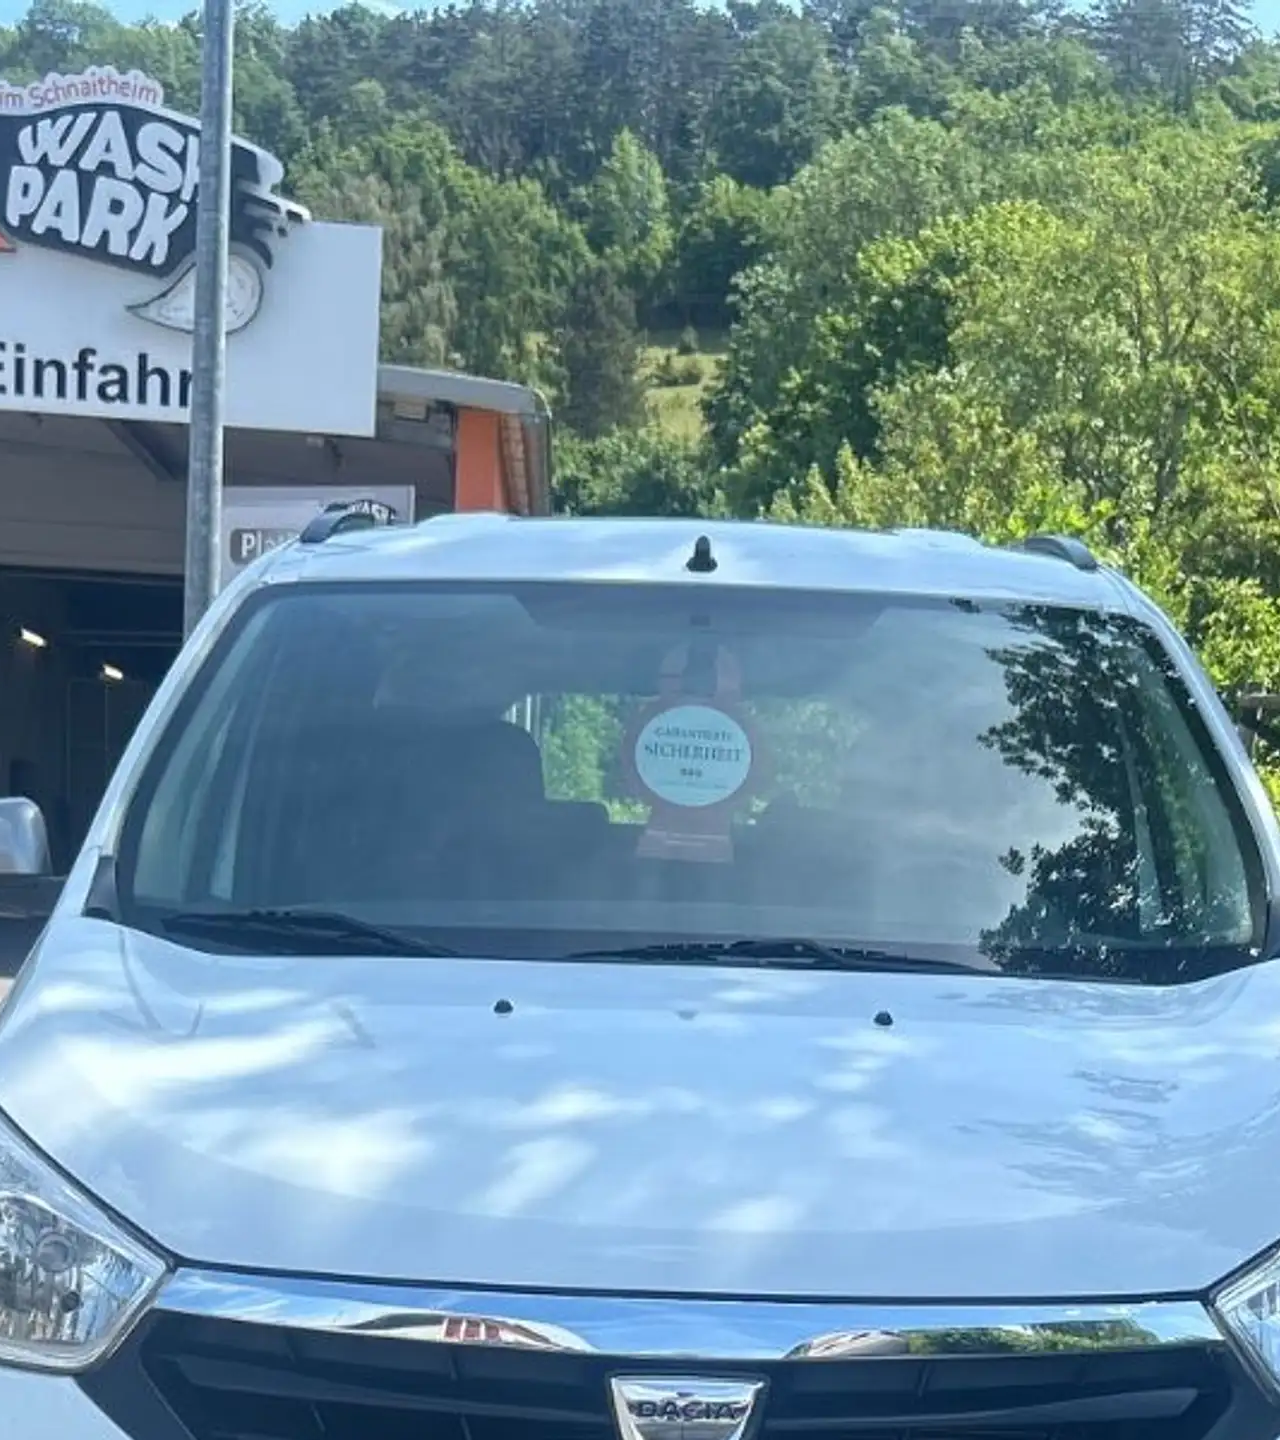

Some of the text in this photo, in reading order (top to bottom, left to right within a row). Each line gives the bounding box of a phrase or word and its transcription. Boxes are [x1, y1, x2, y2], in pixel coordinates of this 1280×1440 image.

[28, 69, 160, 107] Schnaitheim
[5, 164, 188, 265] PARK
[637, 1400, 738, 1420] DACIA
